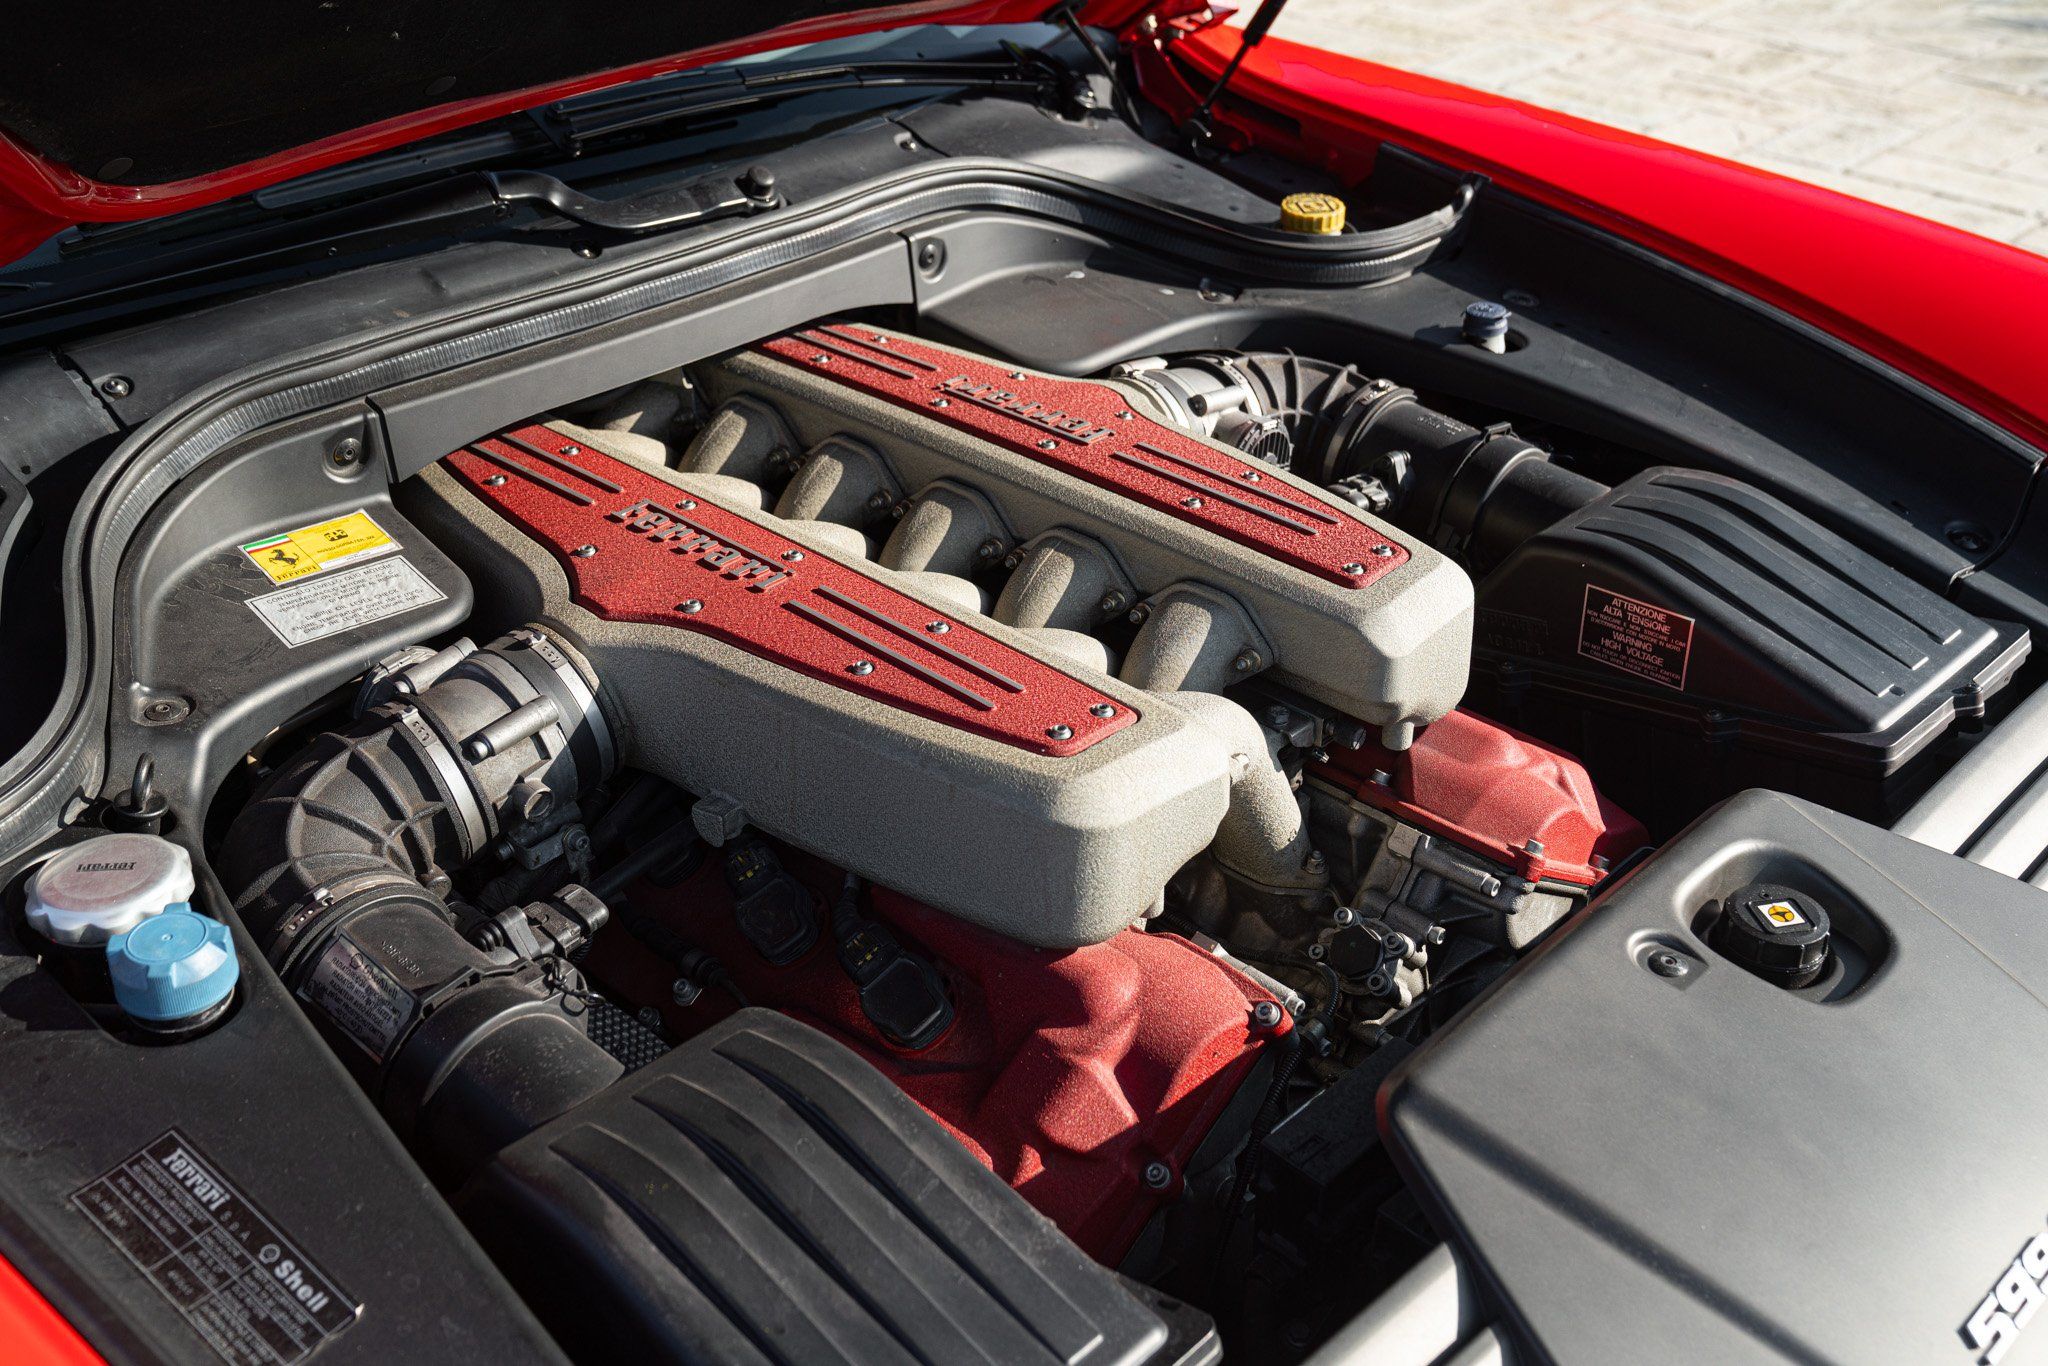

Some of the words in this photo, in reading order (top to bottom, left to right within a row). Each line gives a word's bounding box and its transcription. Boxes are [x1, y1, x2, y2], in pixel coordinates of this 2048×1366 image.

[935, 374, 1115, 445] Ferrari
[611, 498, 796, 590] Ferrari
[275, 564, 317, 580] Ferrari
[361, 563, 393, 575] MOTORE
[304, 609, 333, 620] ENGINE
[372, 588, 399, 599] CHECK
[1611, 597, 1666, 623] ATTENZIONE
[1603, 604, 1623, 618] ALTA
[1626, 612, 1671, 635] TENSIONE
[1600, 636, 1621, 651] HIGH
[1625, 645, 1664, 666] VOLTAGE
[1611, 630, 1653, 652] WARNING
[76, 861, 138, 873] Ferrari
[160, 1146, 232, 1212] Ferrari
[271, 1257, 331, 1313] Shell
